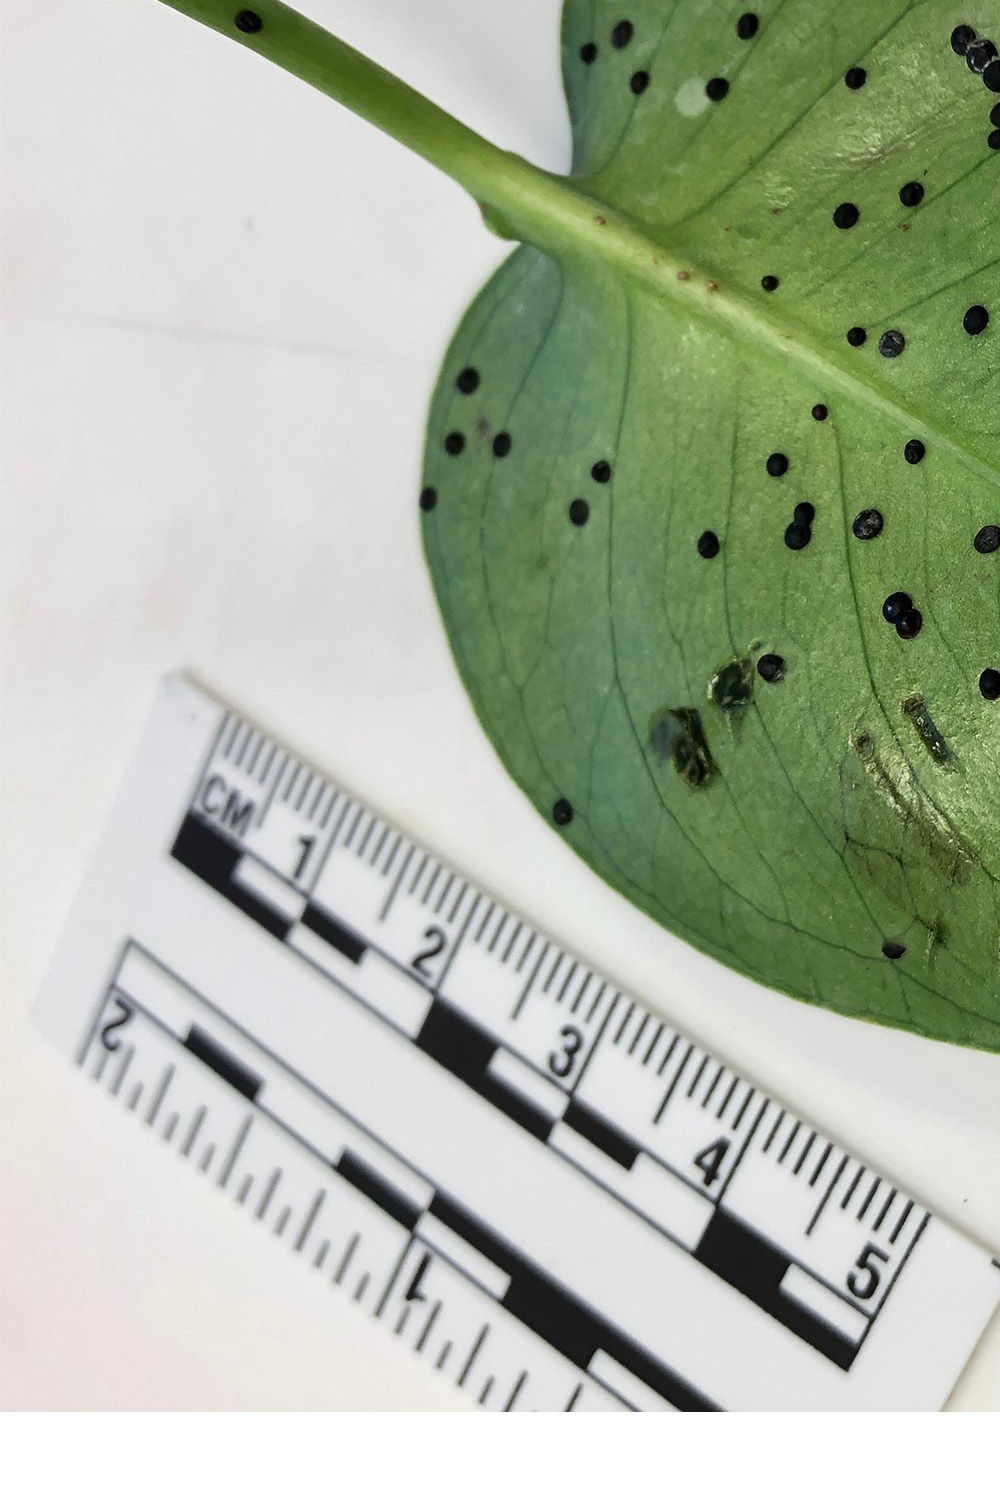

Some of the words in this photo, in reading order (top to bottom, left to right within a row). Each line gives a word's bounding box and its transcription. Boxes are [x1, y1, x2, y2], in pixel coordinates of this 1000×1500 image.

[102, 999, 133, 1051] 2
[202, 775, 254, 837] CM
[294, 834, 316, 879] 1
[412, 926, 446, 979] 2
[549, 1026, 583, 1077] 3
[694, 1136, 731, 1187] 4
[846, 1240, 890, 1300] 5
[405, 1252, 430, 1301] 1
